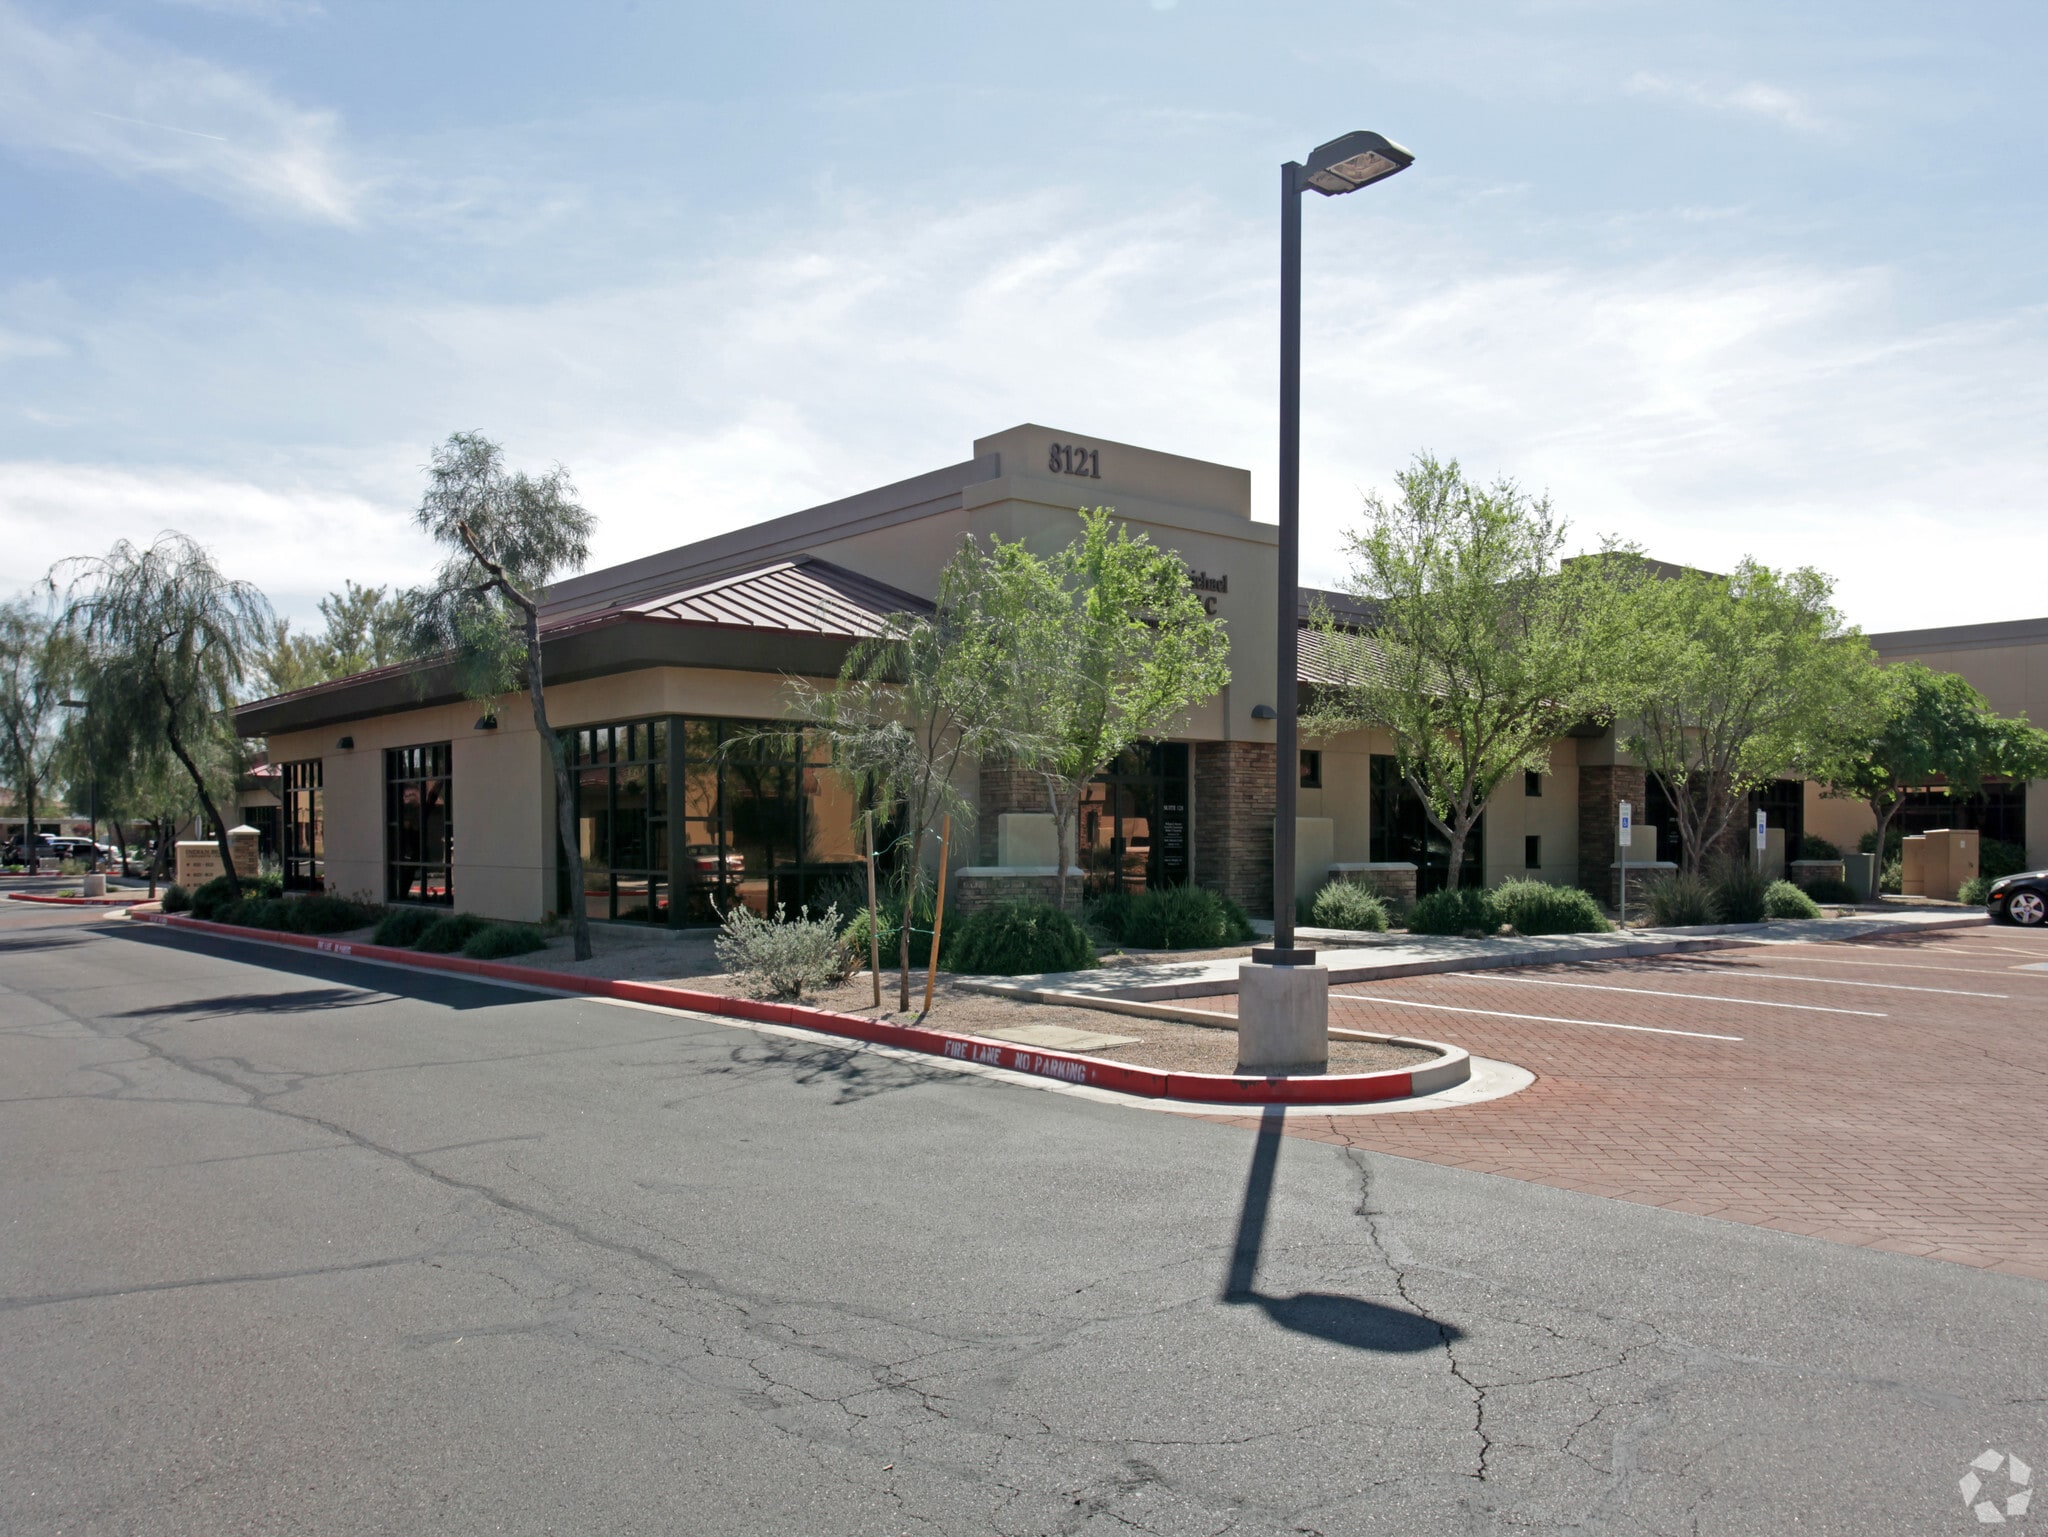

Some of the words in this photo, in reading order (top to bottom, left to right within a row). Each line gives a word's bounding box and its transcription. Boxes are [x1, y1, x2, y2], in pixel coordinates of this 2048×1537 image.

[1049, 442, 1101, 479] 8121
[1188, 570, 1228, 594] ichael
[945, 1040, 968, 1059] FIRE
[972, 1045, 1002, 1065] LANE
[1014, 1052, 1031, 1071] NO
[1033, 1056, 1087, 1082] PARKING
